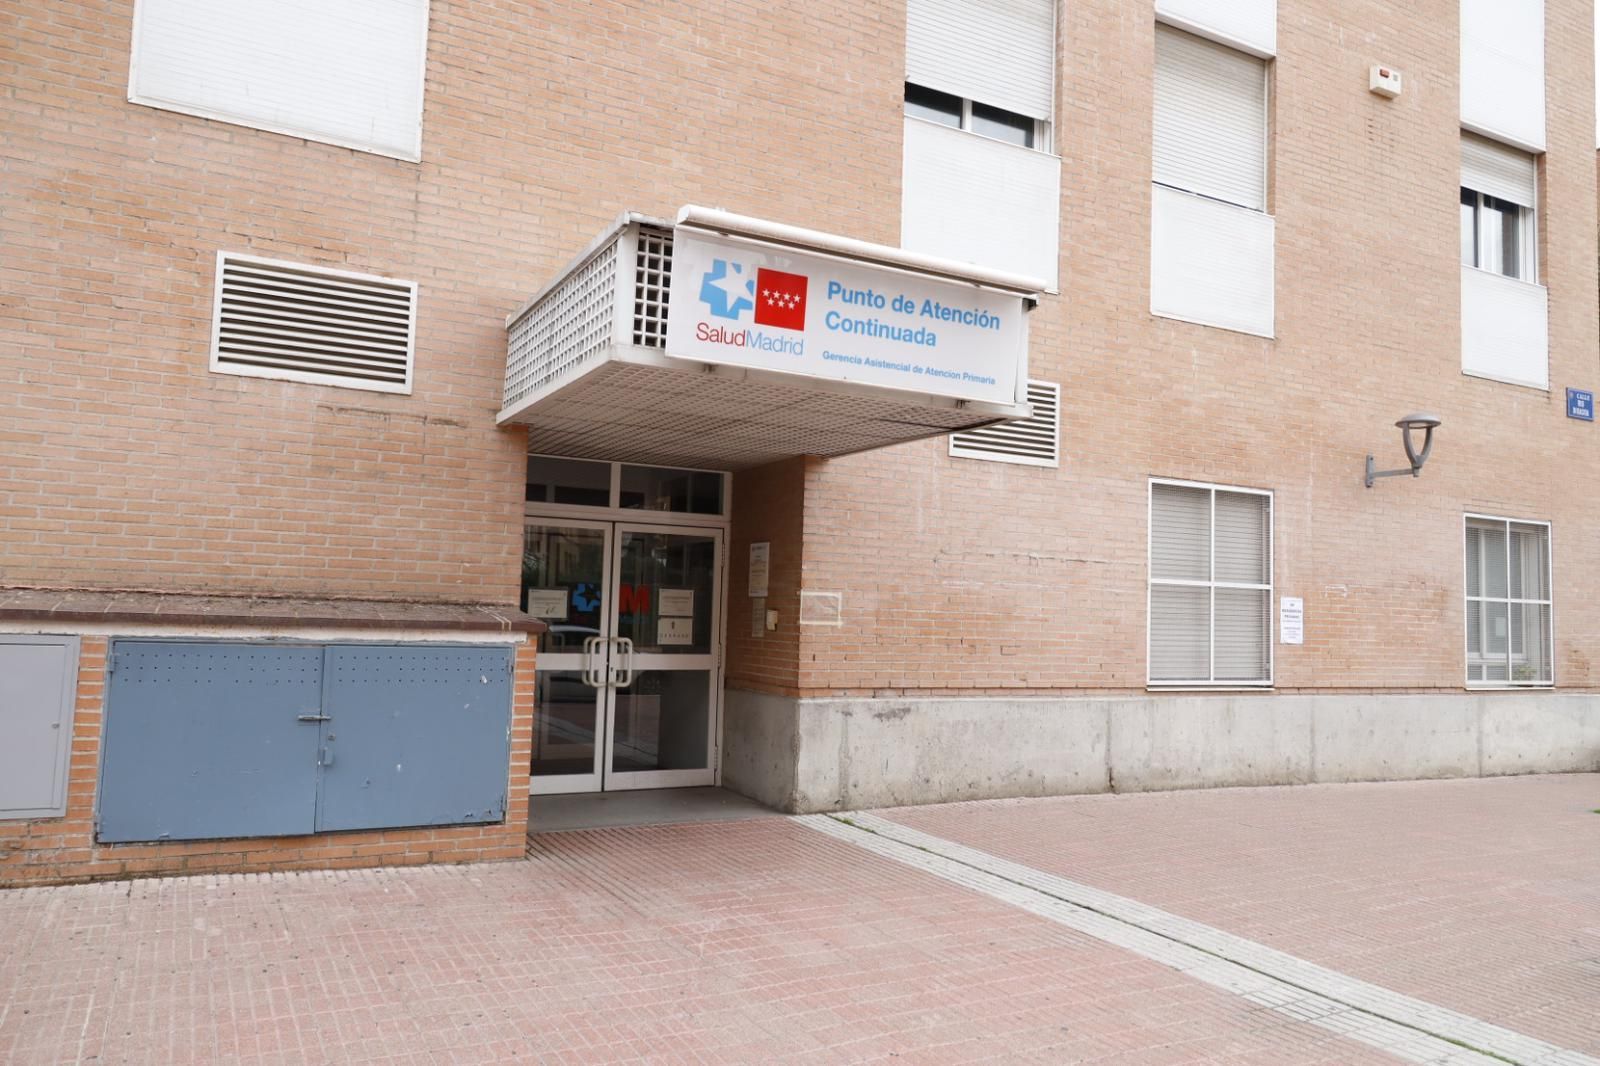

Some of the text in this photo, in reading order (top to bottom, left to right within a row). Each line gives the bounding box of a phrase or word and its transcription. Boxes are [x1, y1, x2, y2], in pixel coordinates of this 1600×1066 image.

[827, 280, 1000, 330] Punto de Atención
[696, 322, 804, 356] SaludMadrid
[824, 310, 937, 347] Continuada
[822, 350, 862, 365] Gerencia
[864, 357, 911, 372] Asistencial
[912, 364, 923, 374] de
[962, 372, 996, 385] Primaria
